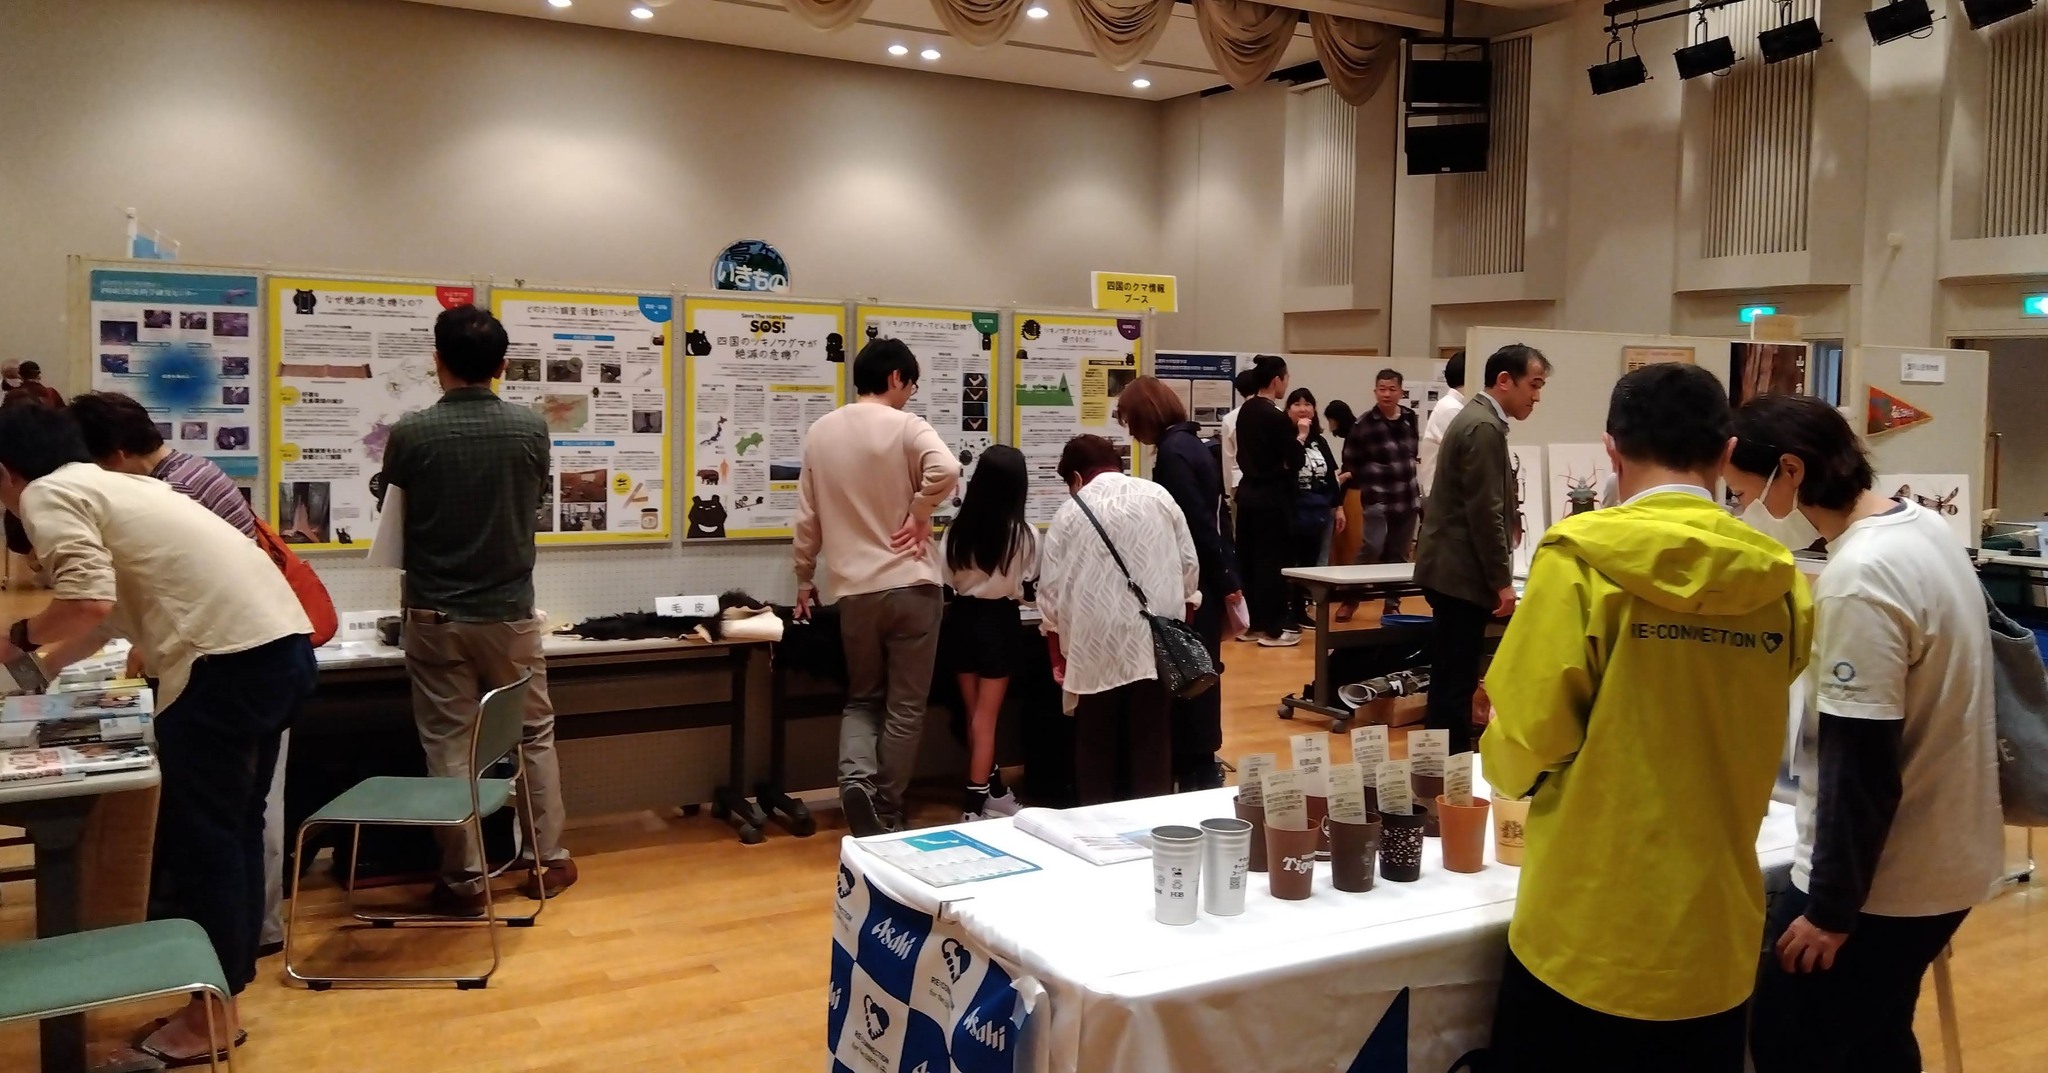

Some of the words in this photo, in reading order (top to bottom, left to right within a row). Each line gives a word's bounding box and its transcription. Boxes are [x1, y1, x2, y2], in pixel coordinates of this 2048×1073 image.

[717, 261, 786, 292] いきもの
[1107, 280, 1165, 294] 四国のクマ情報
[1124, 294, 1149, 304] ブース
[750, 320, 786, 334] SOS!
[716, 336, 817, 348] 四国のツキノワグマが
[670, 603, 706, 614] 毛皮
[1631, 623, 1756, 648] E:CONNETON
[871, 917, 918, 960] Asahi
[963, 1006, 1006, 1052] Asahi
